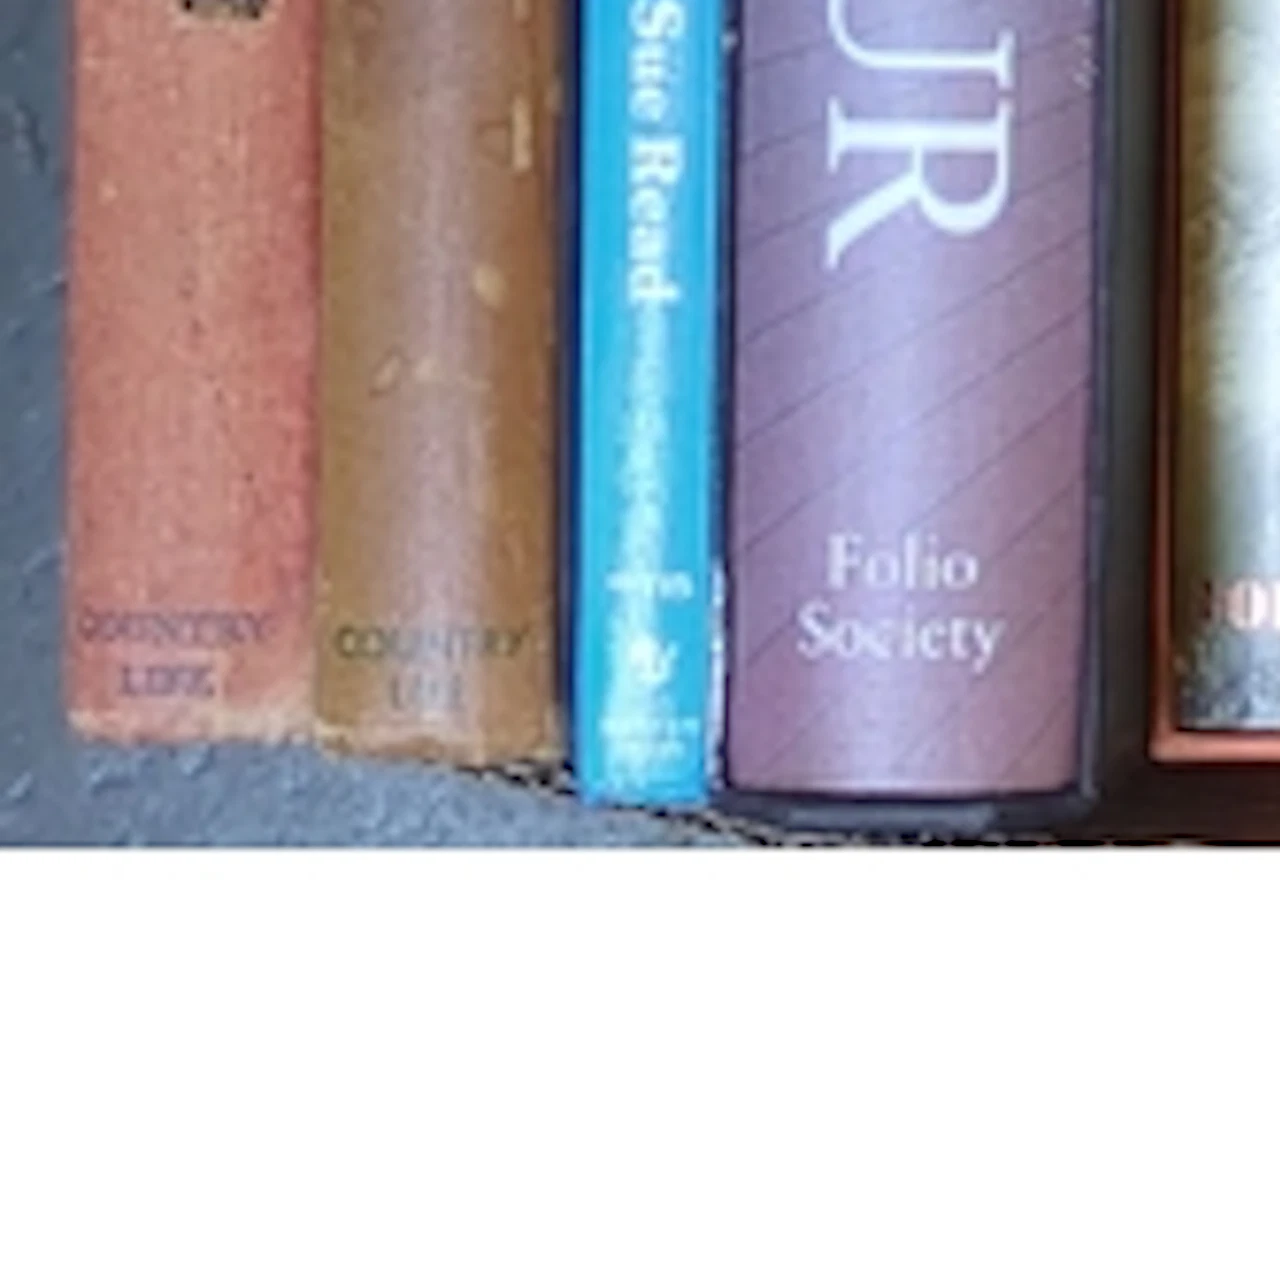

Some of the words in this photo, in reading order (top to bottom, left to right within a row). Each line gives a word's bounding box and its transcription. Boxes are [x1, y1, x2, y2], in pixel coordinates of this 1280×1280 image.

[628, 136, 686, 306] Read
[828, 533, 979, 590] Folio
[797, 598, 1005, 674] Society
